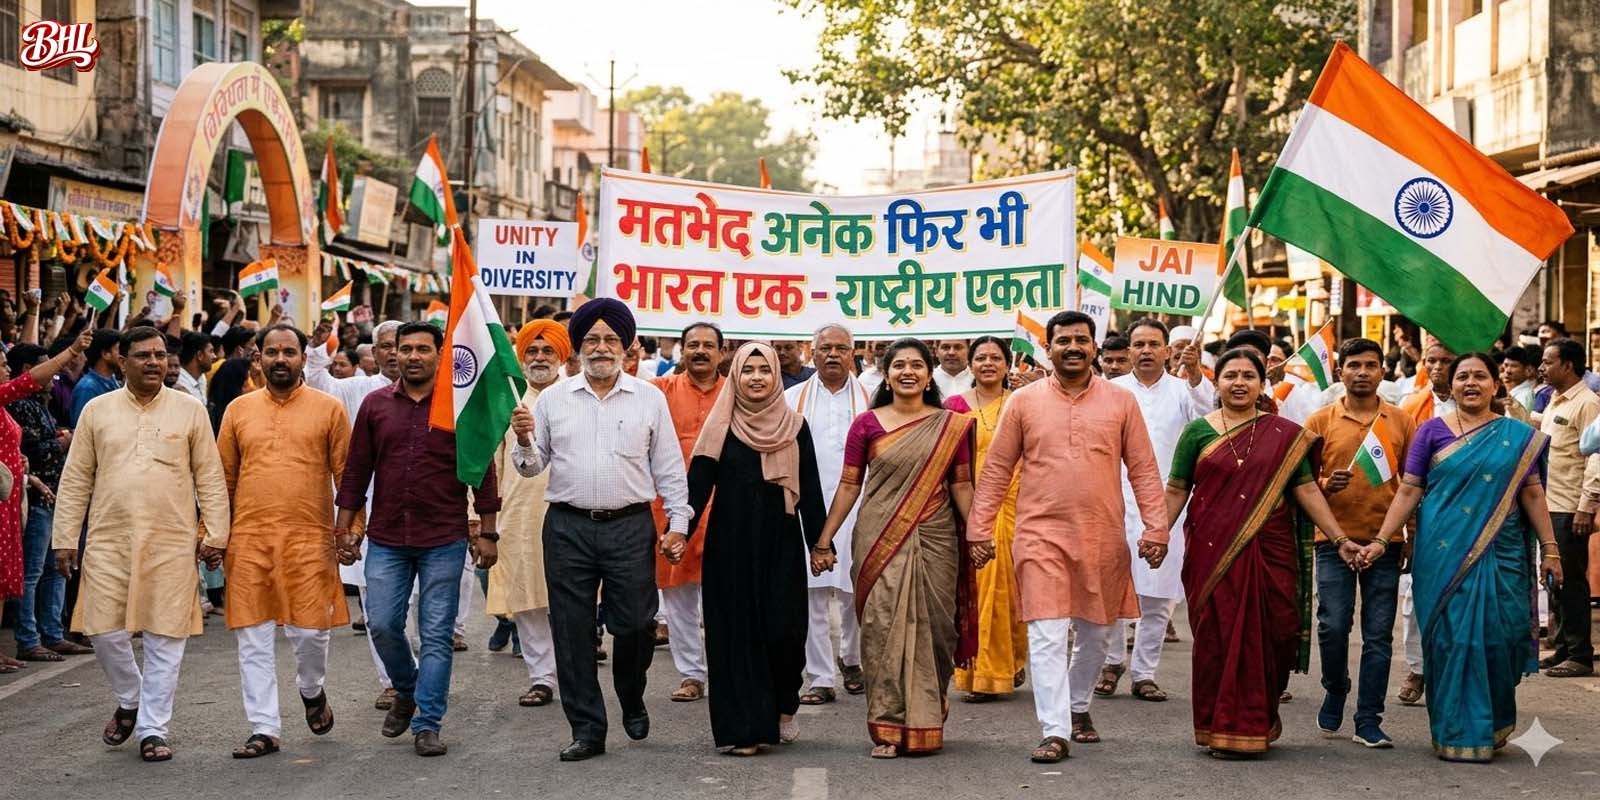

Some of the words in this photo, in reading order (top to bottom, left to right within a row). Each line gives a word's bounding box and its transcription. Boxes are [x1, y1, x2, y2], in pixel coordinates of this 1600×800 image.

[495, 224, 559, 247] UNITY
[617, 192, 753, 257] मतभेद
[761, 200, 873, 254] अनेक
[884, 199, 968, 253] फिर
[976, 191, 1029, 247] भी
[515, 250, 535, 265] IN
[1138, 245, 1194, 275] JAI
[480, 267, 577, 291] DIVERSITY
[613, 263, 726, 313] भारत
[732, 272, 805, 316] एक
[811, 291, 828, 299] -
[836, 259, 957, 325] राष्ट्रीय
[963, 264, 1064, 313] एकता
[1122, 279, 1201, 310] HIND
